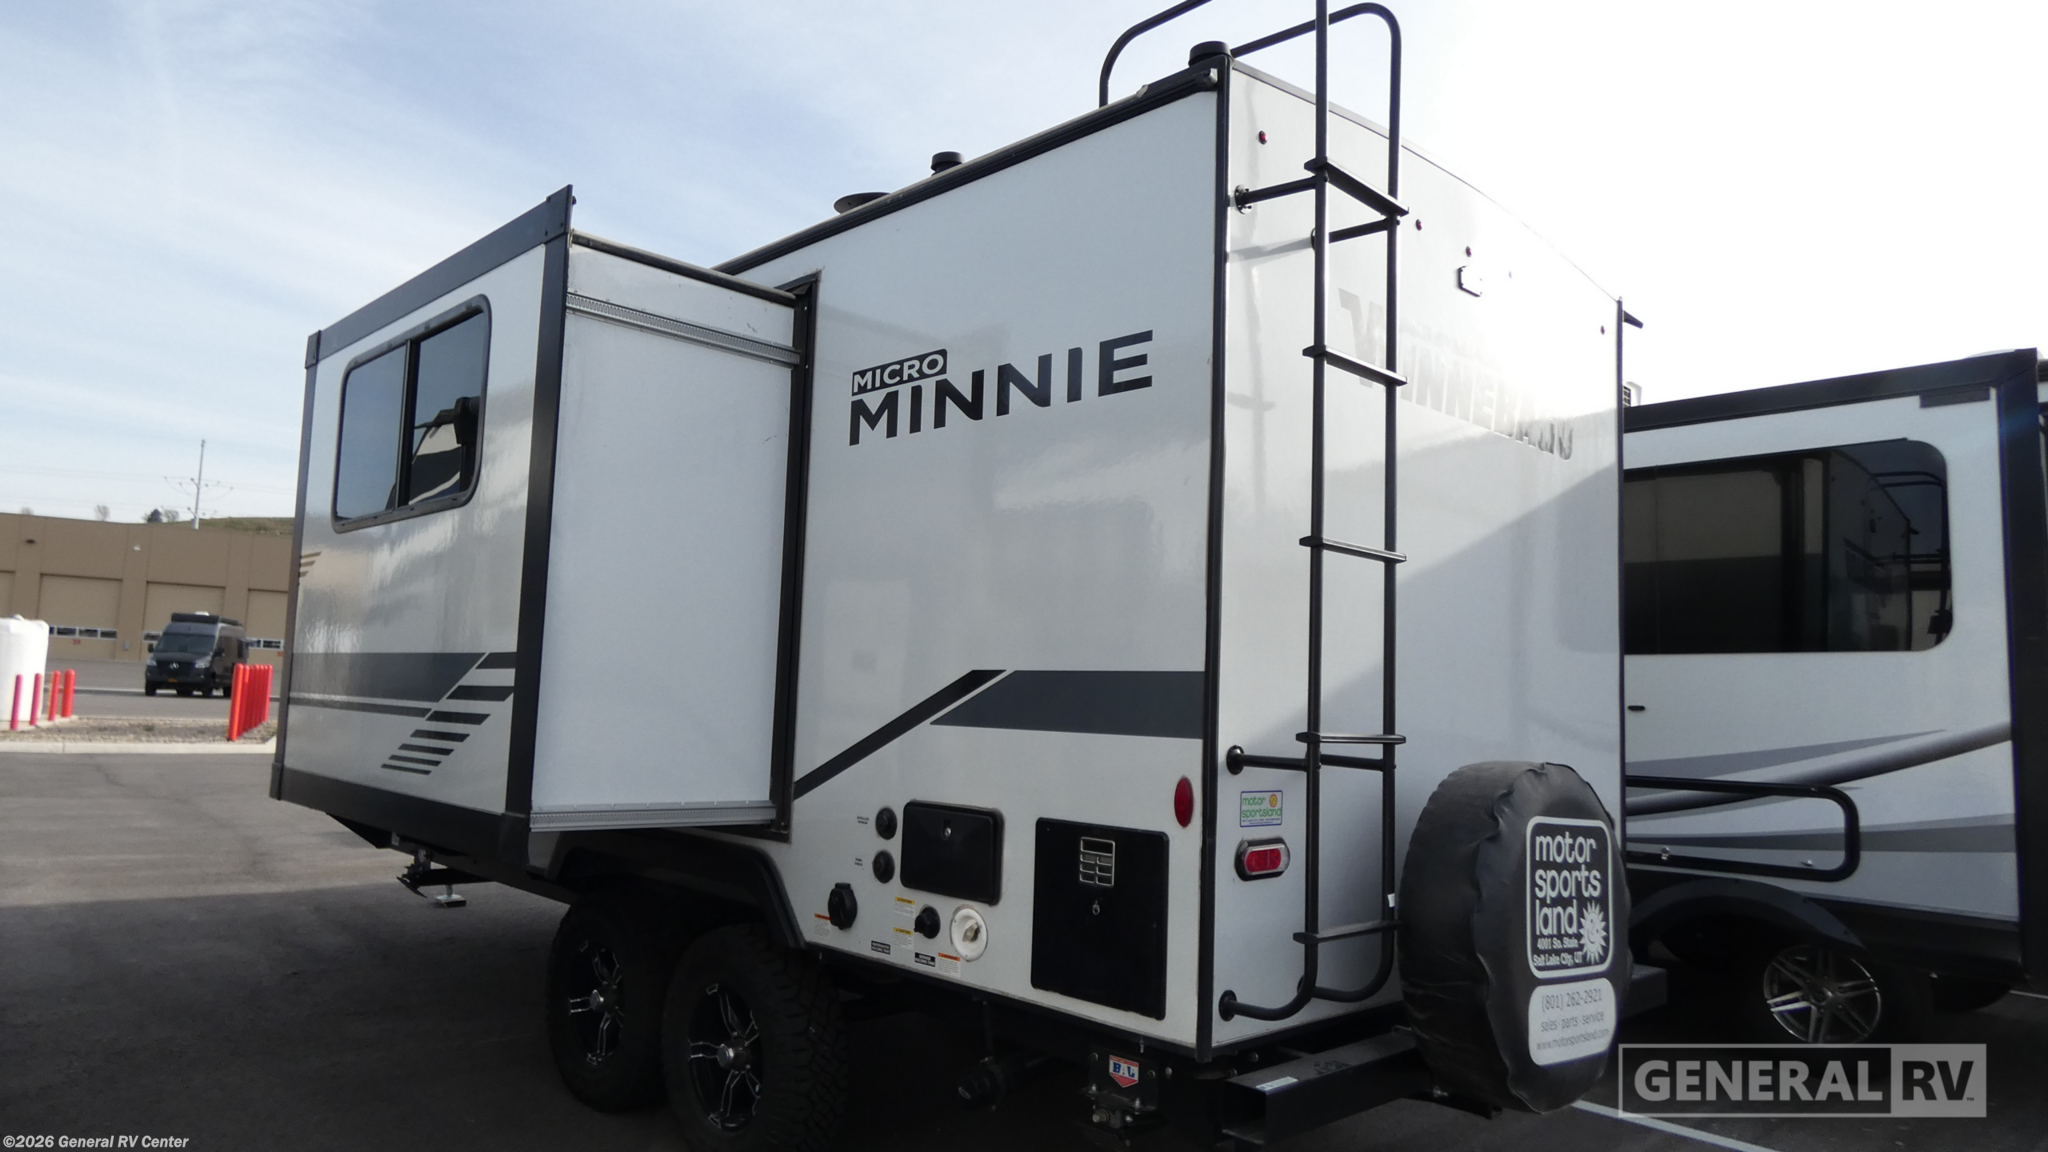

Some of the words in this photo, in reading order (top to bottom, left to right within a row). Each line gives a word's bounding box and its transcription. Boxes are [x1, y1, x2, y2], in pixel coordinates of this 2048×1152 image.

[853, 353, 945, 393] MICRO
[849, 330, 1154, 447] MINNIE
[1242, 796, 1266, 806] motor
[1242, 807, 1282, 819] sportsland
[1535, 831, 1597, 863] motor
[1534, 864, 1602, 904] sports
[1535, 899, 1578, 936] land
[1537, 938, 1552, 950] 4001
[1563, 936, 1579, 948] State
[1533, 954, 1545, 967] Salt
[1545, 953, 1560, 966] Lake
[1574, 951, 1583, 963] UT
[1541, 993, 1564, 1013] (801)
[1566, 988, 1603, 1007] 262-2921
[1541, 1017, 1559, 1033] sales
[1561, 1016, 1579, 1031] parts
[1581, 1011, 1605, 1025] service
[1112, 1061, 1136, 1079] BL
